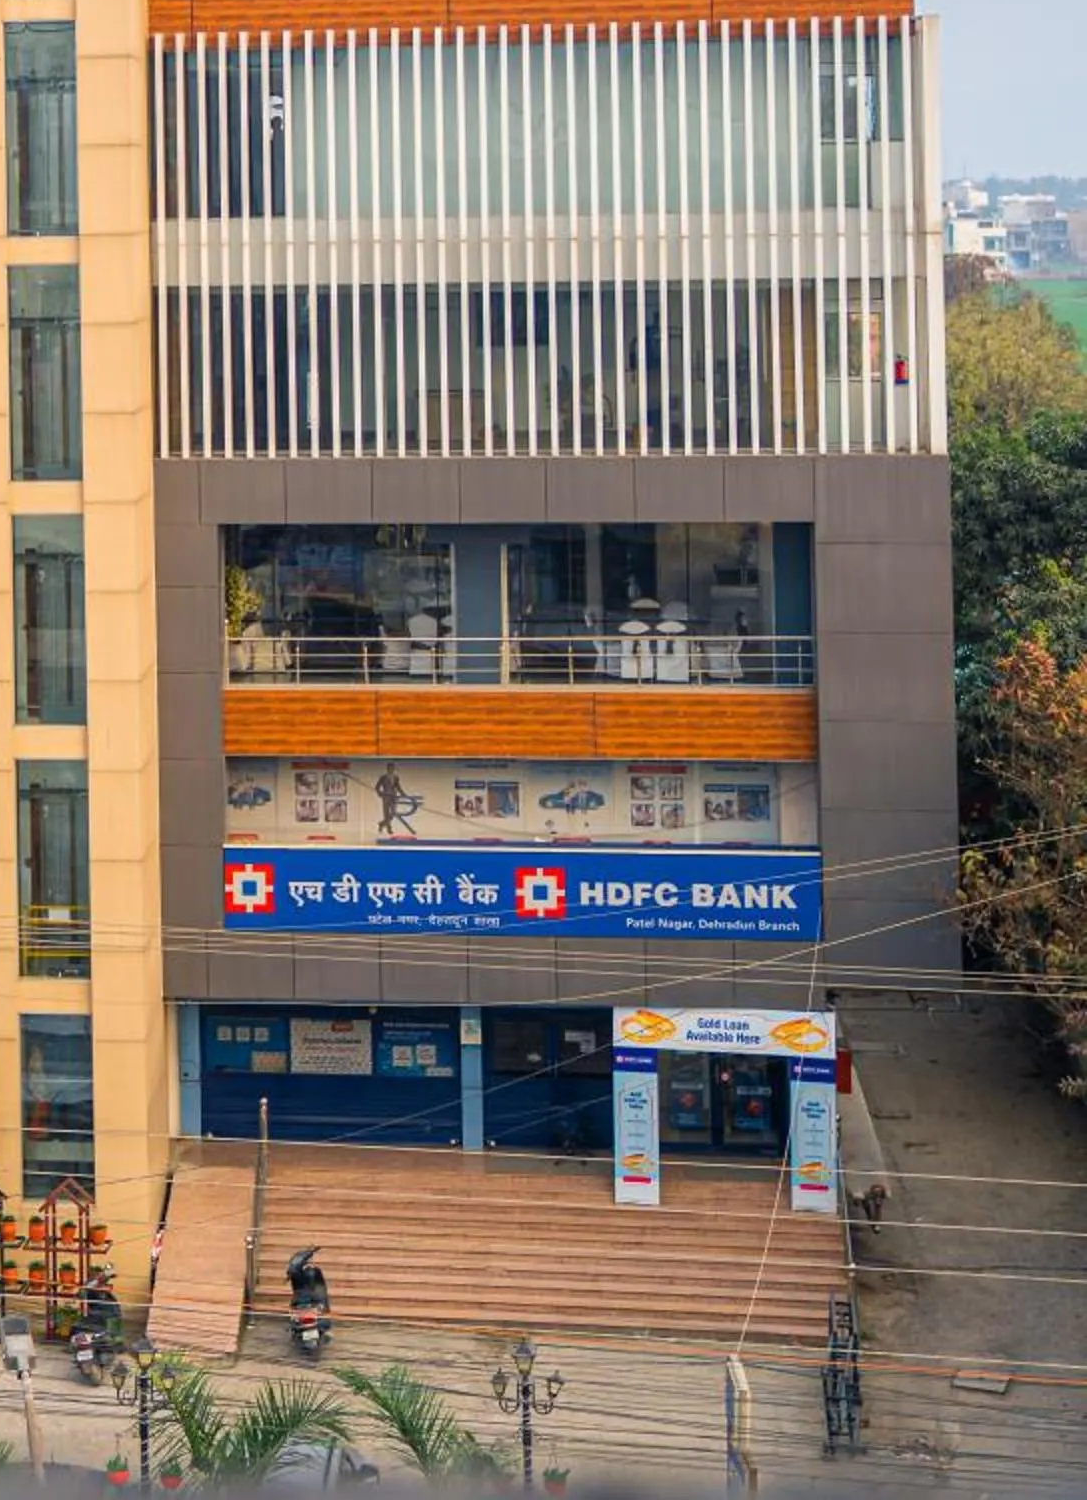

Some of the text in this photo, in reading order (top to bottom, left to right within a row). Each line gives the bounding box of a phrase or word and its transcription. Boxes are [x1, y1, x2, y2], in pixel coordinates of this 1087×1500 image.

[288, 872, 501, 908] एच डी एफ सी बैंक
[579, 881, 798, 909] HDFC BANK
[626, 916, 656, 930] Patel
[698, 918, 755, 931] Dehradun
[758, 919, 800, 931] Branch
[696, 1017, 750, 1032] Gold Loan
[686, 1030, 761, 1045] Available Here
